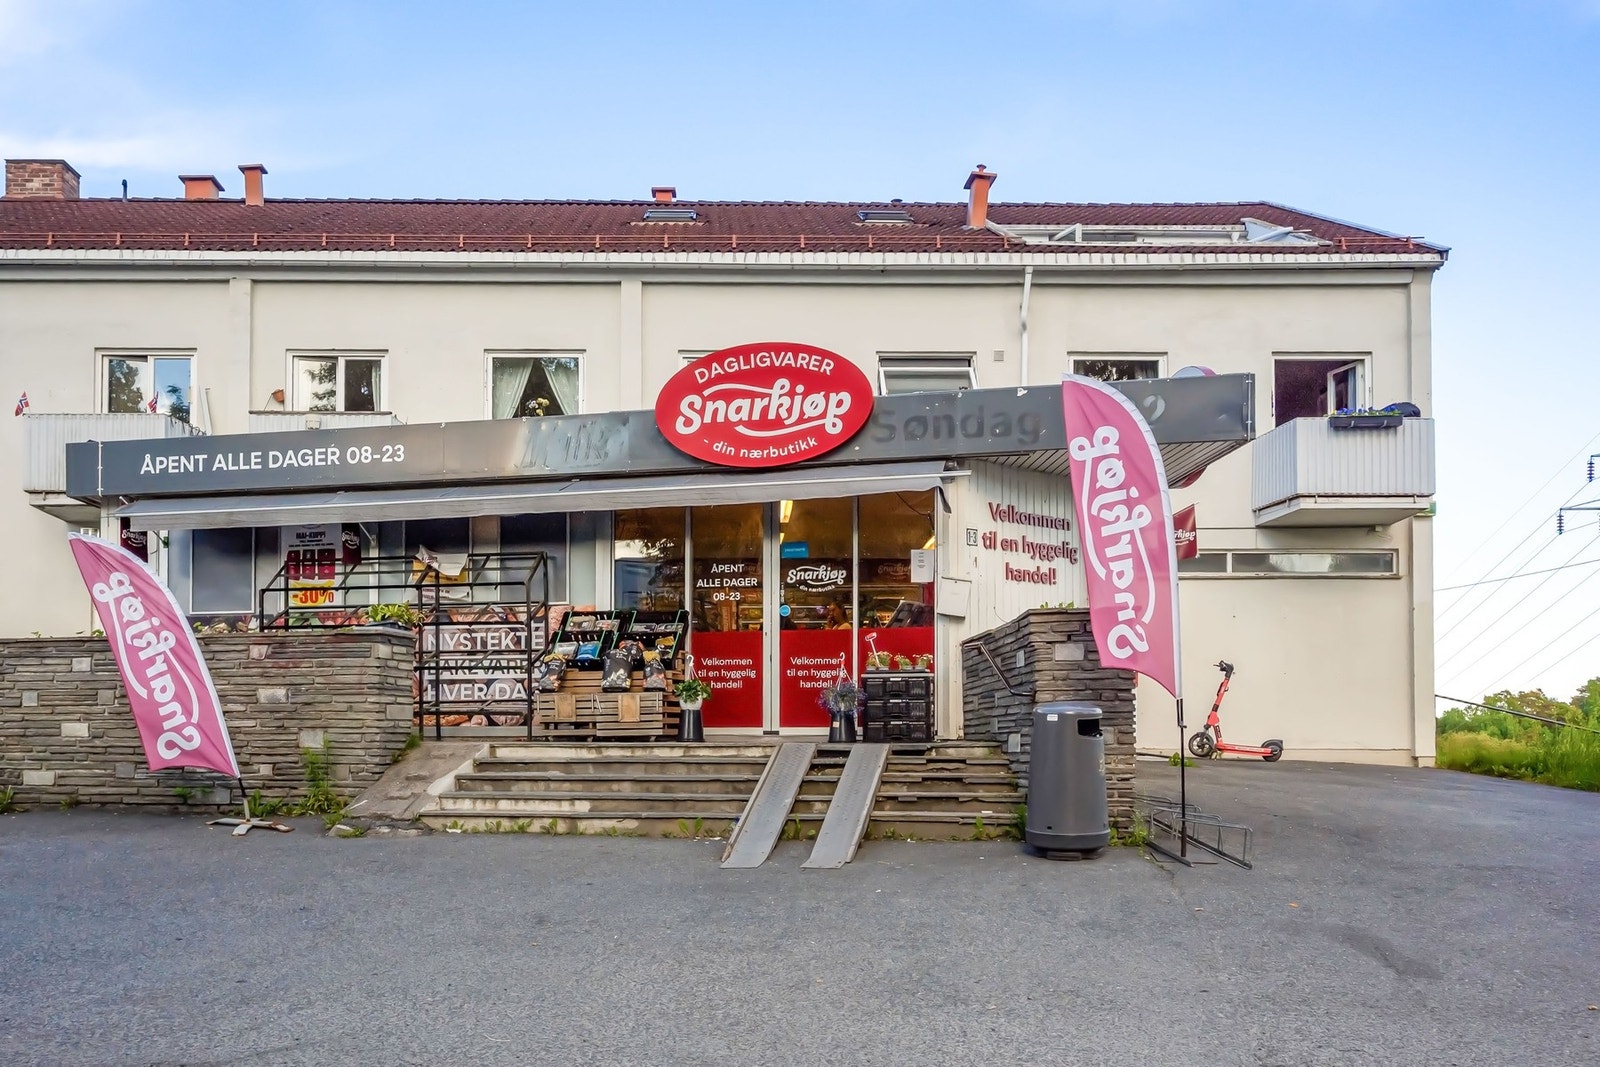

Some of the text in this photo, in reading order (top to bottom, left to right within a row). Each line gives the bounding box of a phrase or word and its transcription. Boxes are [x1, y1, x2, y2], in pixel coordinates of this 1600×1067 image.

[694, 351, 835, 384] DAGLIGVARER
[675, 378, 852, 437] Snarkjøp
[712, 438, 735, 456] din
[740, 436, 818, 459] nærbutikk
[140, 444, 405, 475] ÅPENT ALLE DAGER 08-23
[988, 502, 1071, 531] Velkommen
[982, 531, 1079, 565] til en hyggelig
[710, 563, 745, 573] ÅPENT
[786, 565, 847, 585] Snarkjøp
[1005, 562, 1057, 586] handel!
[696, 577, 758, 587] ALLE DAGER
[292, 586, 335, 604] -30%
[713, 592, 741, 601] 08-23
[427, 632, 545, 650] NYSTEKTE
[701, 657, 753, 666] Velkommen
[698, 669, 707, 677] til
[721, 669, 757, 679] hyggelig
[786, 668, 796, 677] til
[797, 669, 809, 677] en
[427, 683, 538, 700] HVER DA
[710, 680, 743, 689] handel!
[800, 679, 833, 688] handel!
